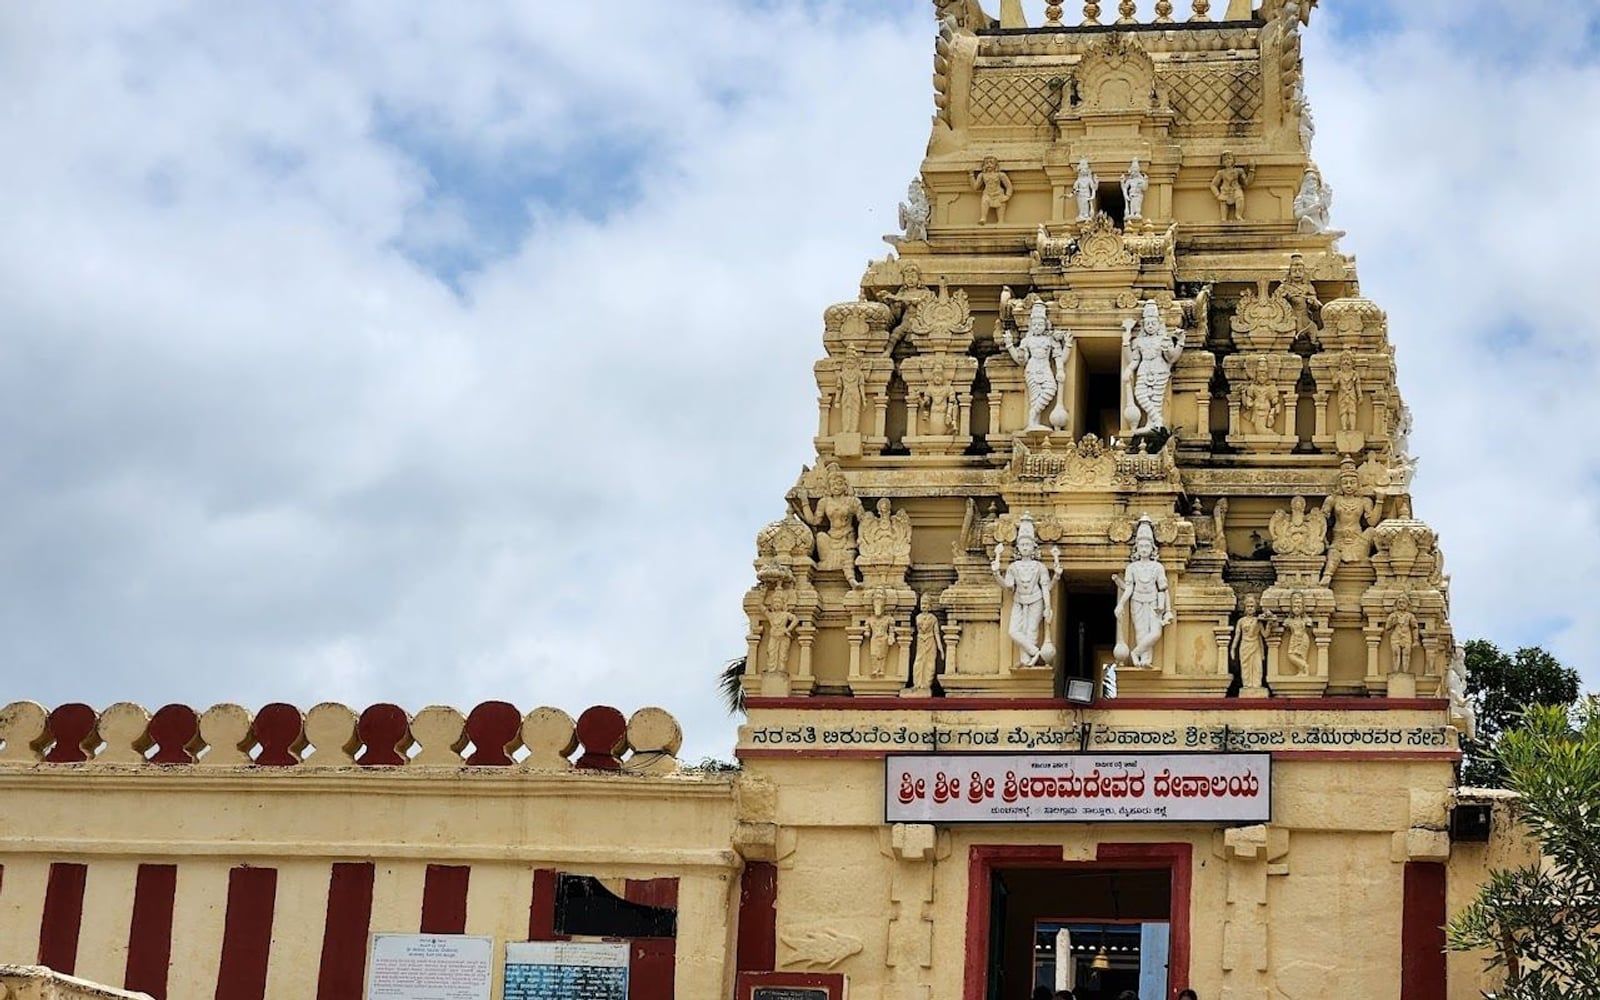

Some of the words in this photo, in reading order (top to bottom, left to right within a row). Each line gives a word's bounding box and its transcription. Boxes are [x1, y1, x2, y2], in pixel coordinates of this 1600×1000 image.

[752, 726, 817, 744] ನರಪತಿ
[957, 728, 999, 745] ಗಂಡ
[1094, 726, 1177, 744] ಮಹಾರಾಜ
[898, 771, 925, 804] ಶ್ರೀ
[933, 771, 960, 804] ಶ್ರೀ
[967, 771, 995, 804] ಶ್ರೀ
[1002, 769, 1145, 803] ಶ್ರೀರಾಮದೇವರ
[1153, 768, 1260, 798] ದೇವಾಲಯ
